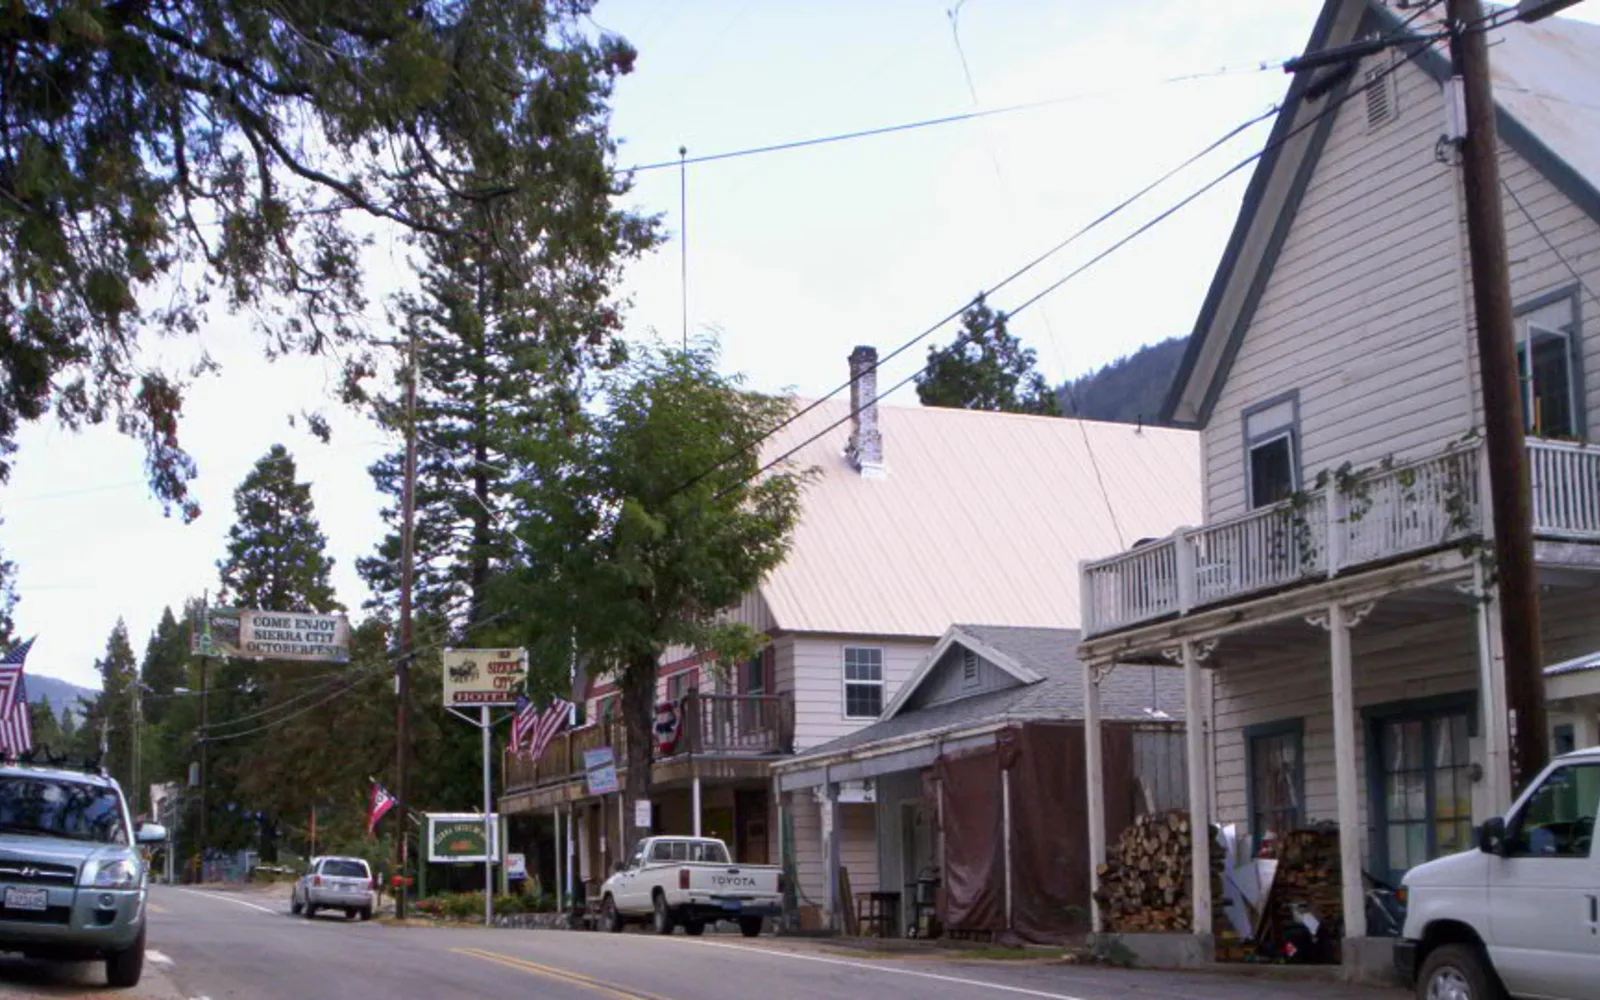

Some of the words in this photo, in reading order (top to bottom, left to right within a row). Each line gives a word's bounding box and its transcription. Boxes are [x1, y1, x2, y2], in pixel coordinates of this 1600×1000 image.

[253, 616, 291, 628] COME
[295, 619, 336, 631] ENJOY
[254, 629, 302, 642] SIERRA
[306, 631, 334, 643] CITY
[711, 875, 756, 886] TOYOTA
